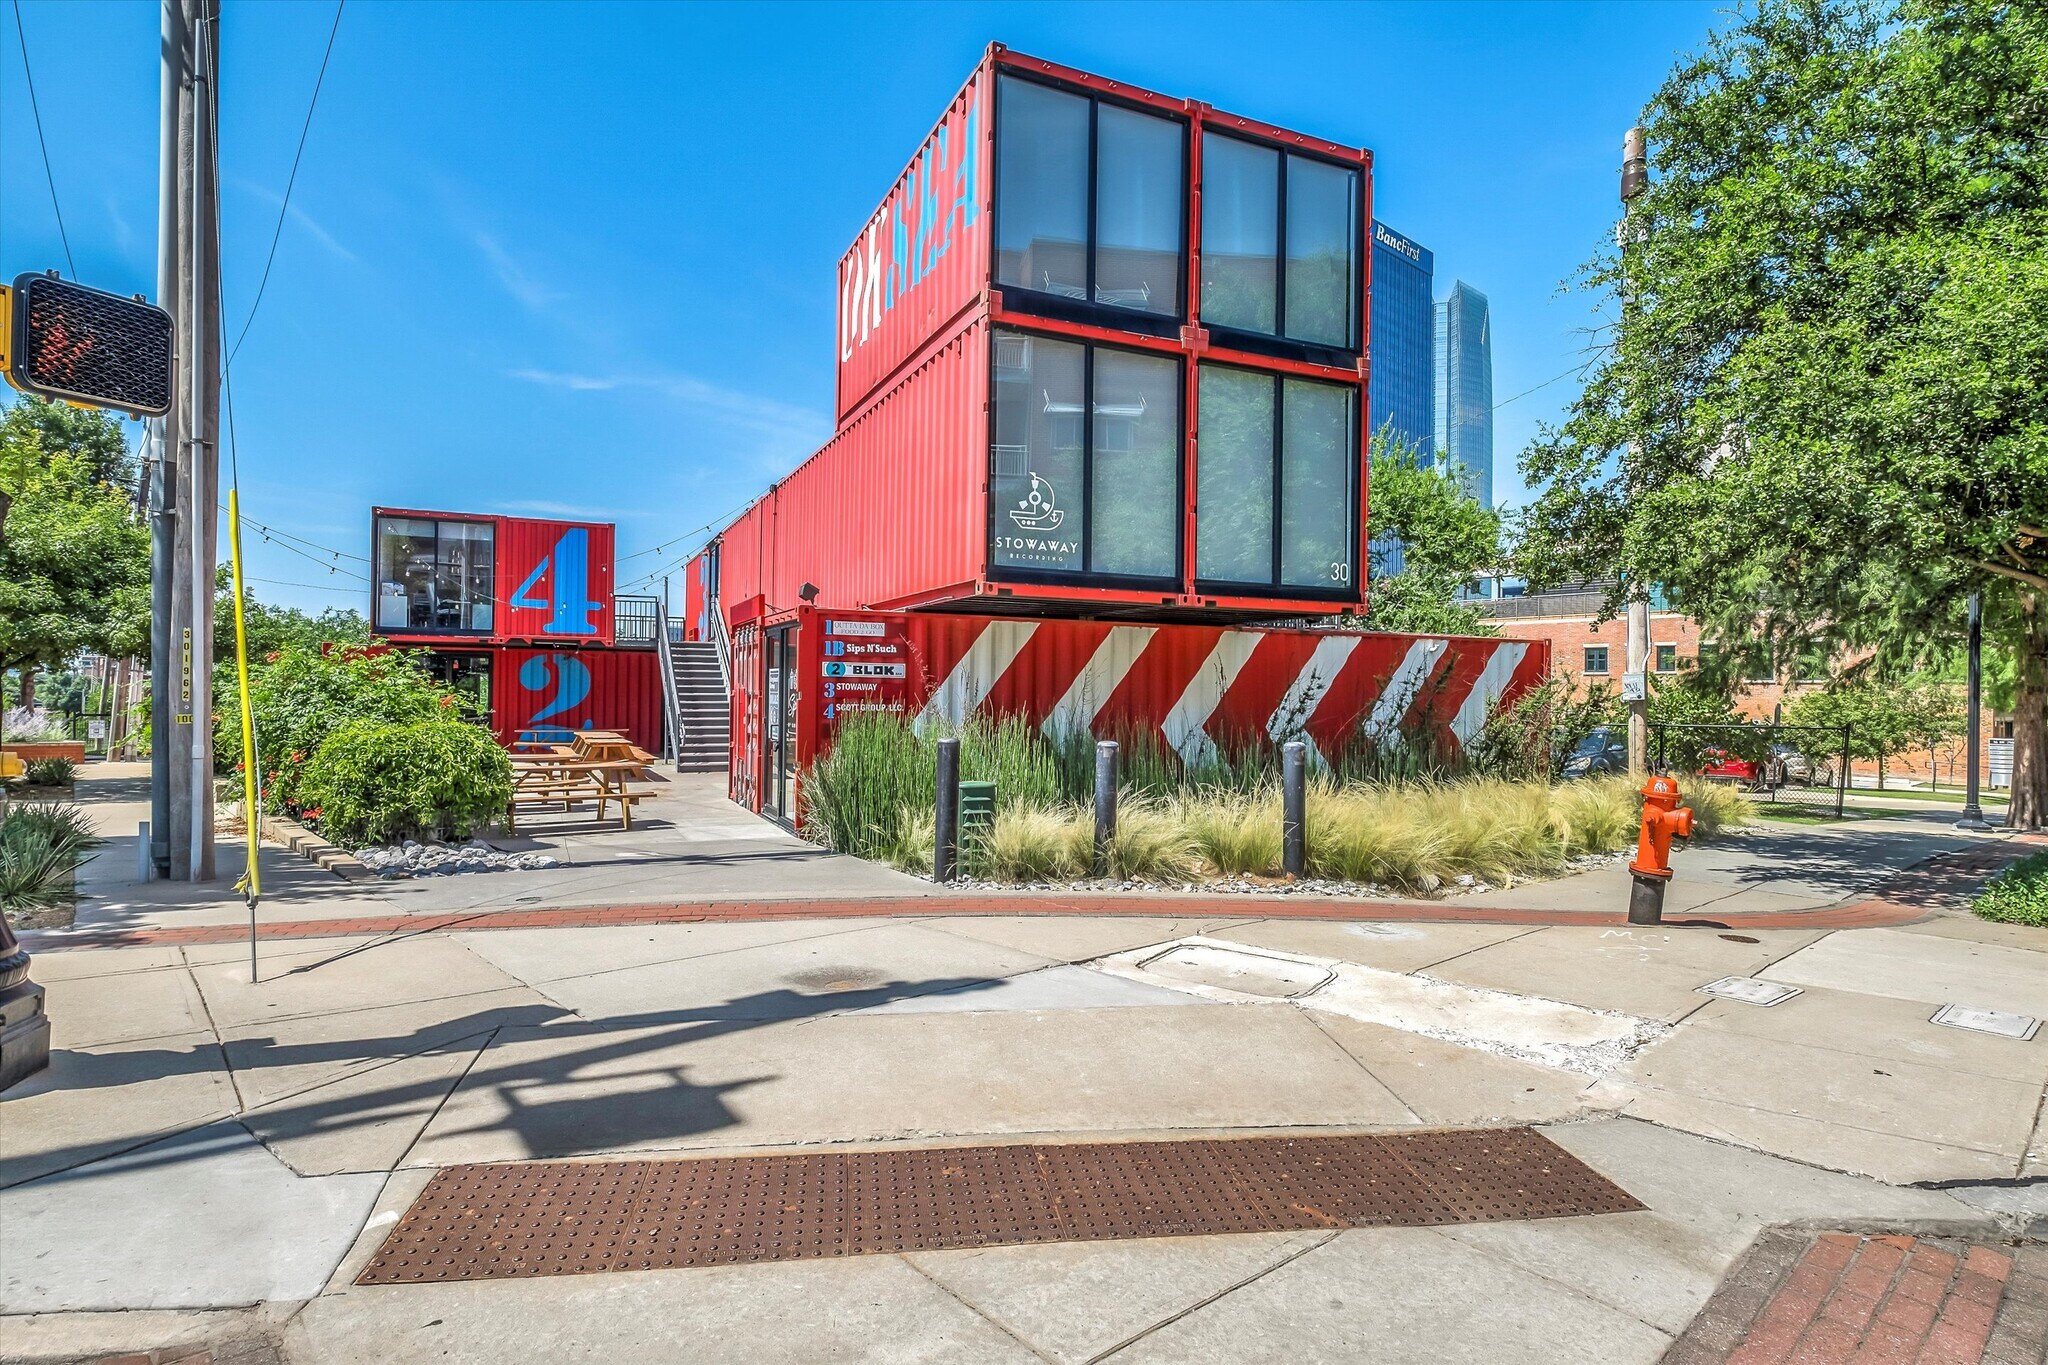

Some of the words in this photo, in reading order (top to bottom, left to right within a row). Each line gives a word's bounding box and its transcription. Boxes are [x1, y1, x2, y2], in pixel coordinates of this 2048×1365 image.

[1376, 224, 1419, 261] BancFirst
[996, 537, 1078, 553] STOWAWAY
[1010, 553, 1063, 561] RECORDING
[1331, 562, 1349, 581] 30
[509, 528, 602, 634] 4
[825, 620, 832, 635] 1
[825, 641, 844, 656] 1B
[846, 644, 866, 654] Sips
[831, 663, 840, 674] 2
[852, 666, 894, 675] BLOK
[824, 683, 835, 697] 3
[518, 654, 593, 751] 2
[823, 703, 835, 718] 4
